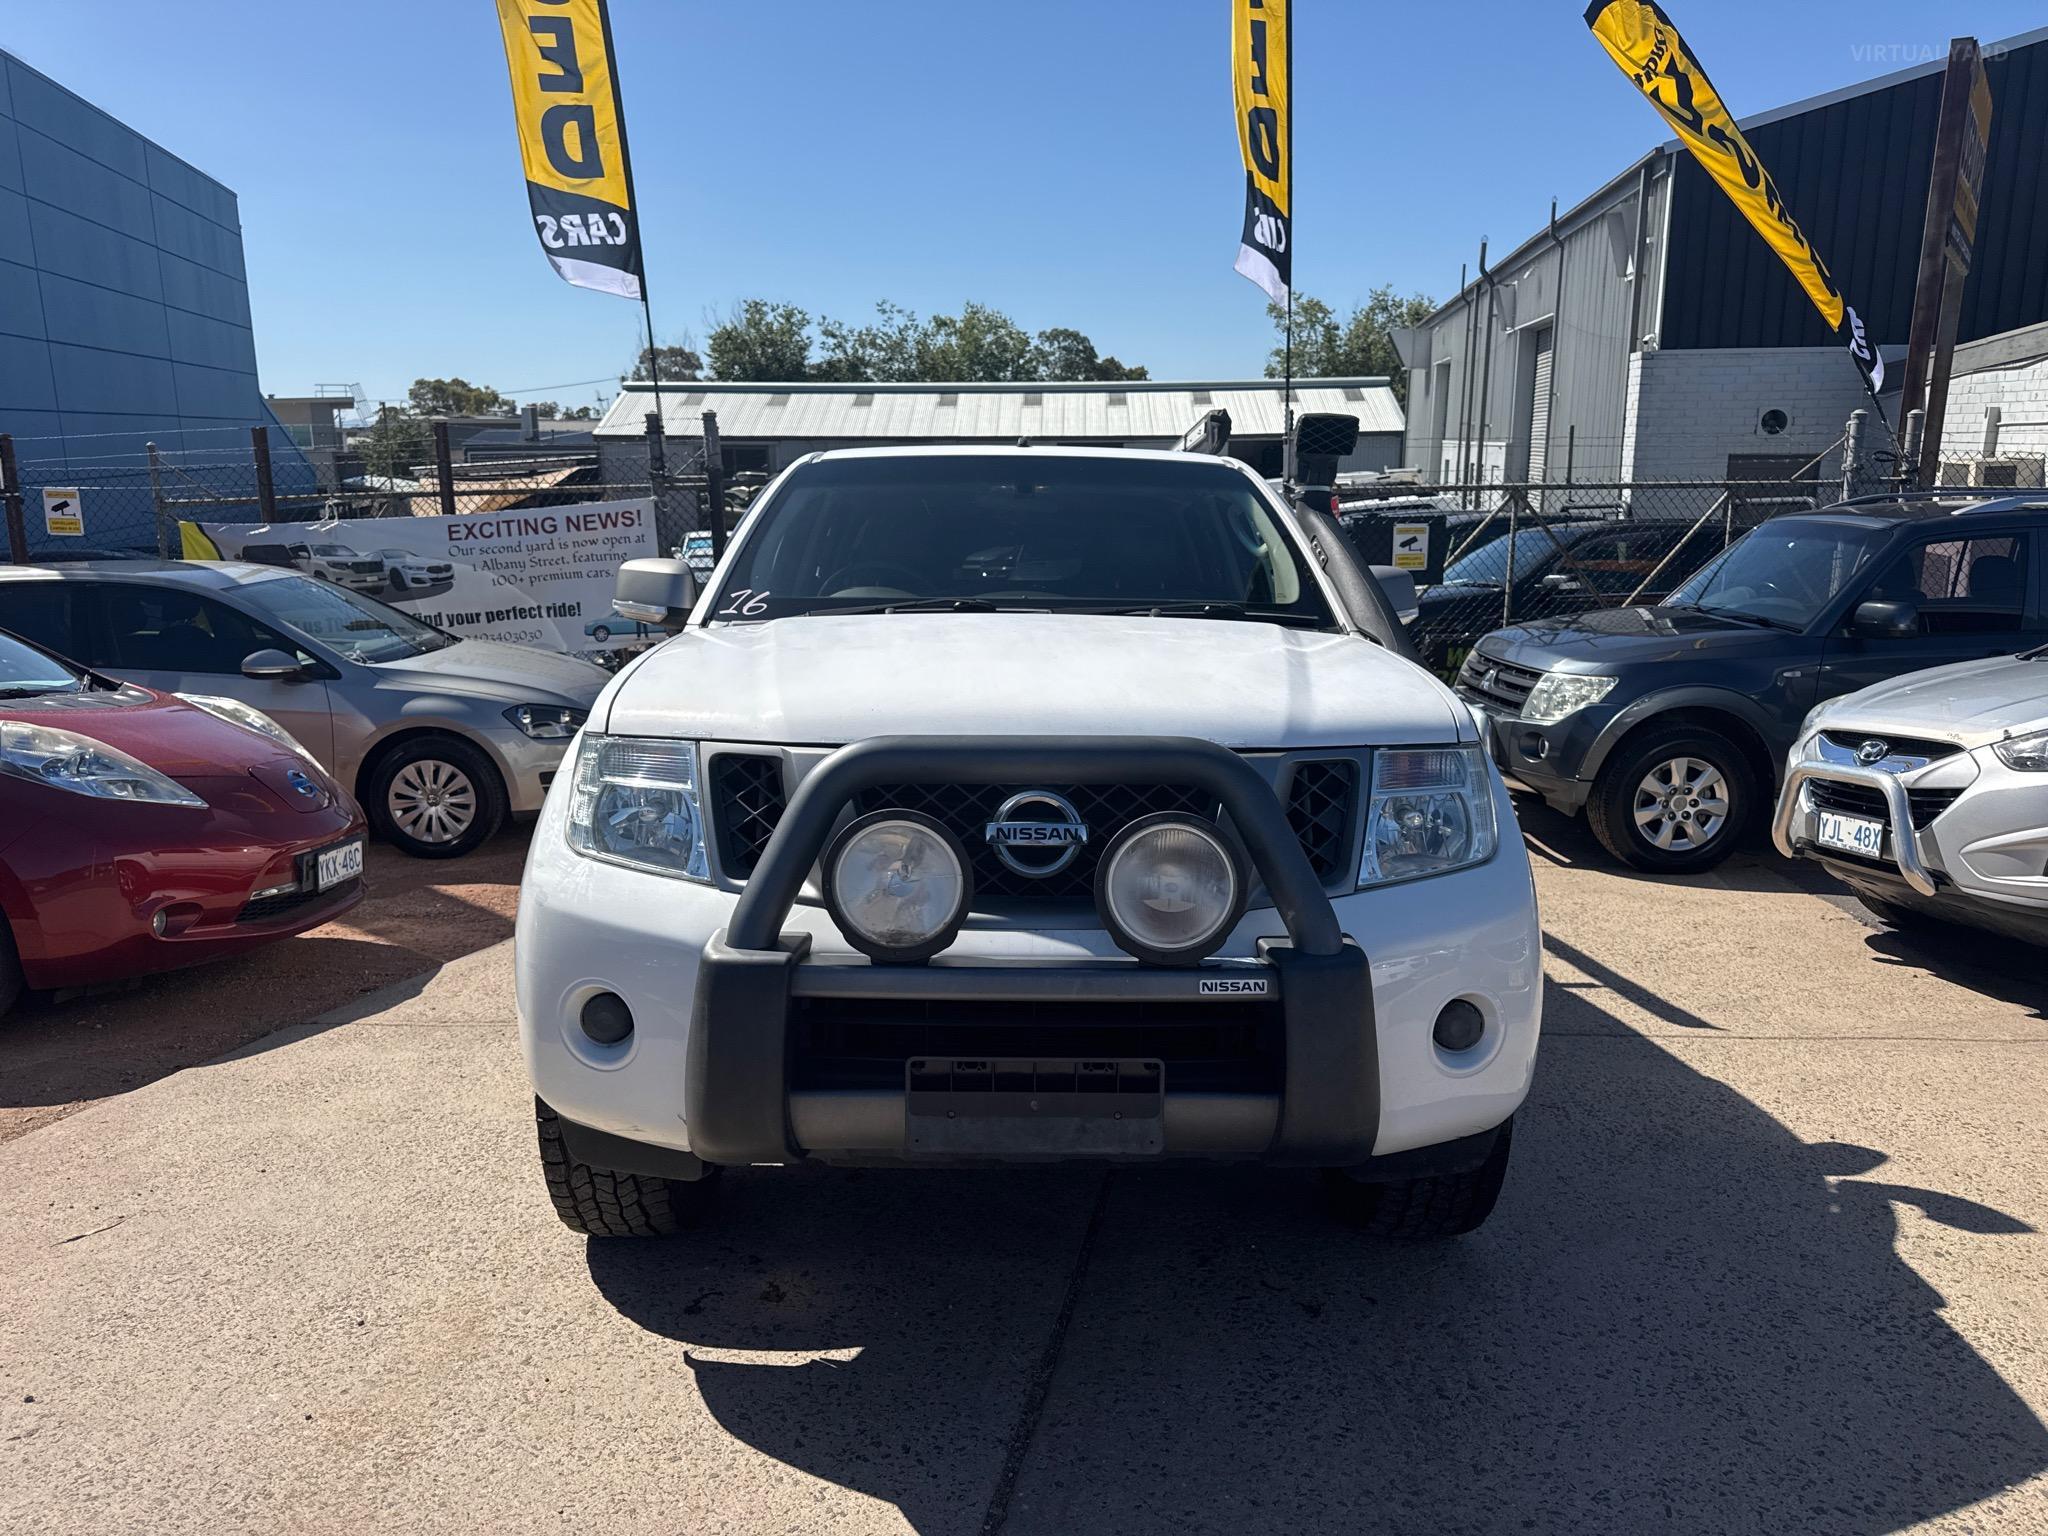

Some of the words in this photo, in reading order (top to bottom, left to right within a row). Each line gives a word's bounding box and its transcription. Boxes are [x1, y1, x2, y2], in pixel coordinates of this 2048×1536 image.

[448, 516, 558, 541] EXCITING
[565, 509, 642, 533] NEWS!
[448, 544, 476, 557] Our
[479, 540, 522, 555] second
[526, 538, 555, 556] yard
[558, 537, 569, 550] is
[572, 538, 598, 548] now
[602, 535, 631, 549] open
[634, 533, 646, 544] at
[481, 558, 526, 573] Albany
[573, 548, 628, 564] featuring
[492, 574, 523, 586] 100+
[528, 568, 583, 587] premium
[586, 568, 614, 579] cars.
[719, 589, 771, 616] 16
[447, 611, 482, 628] your
[485, 604, 544, 624] perfect
[546, 602, 582, 618] ride!
[996, 827, 1079, 841] NISSAN
[1201, 981, 1266, 992] NISSAN
